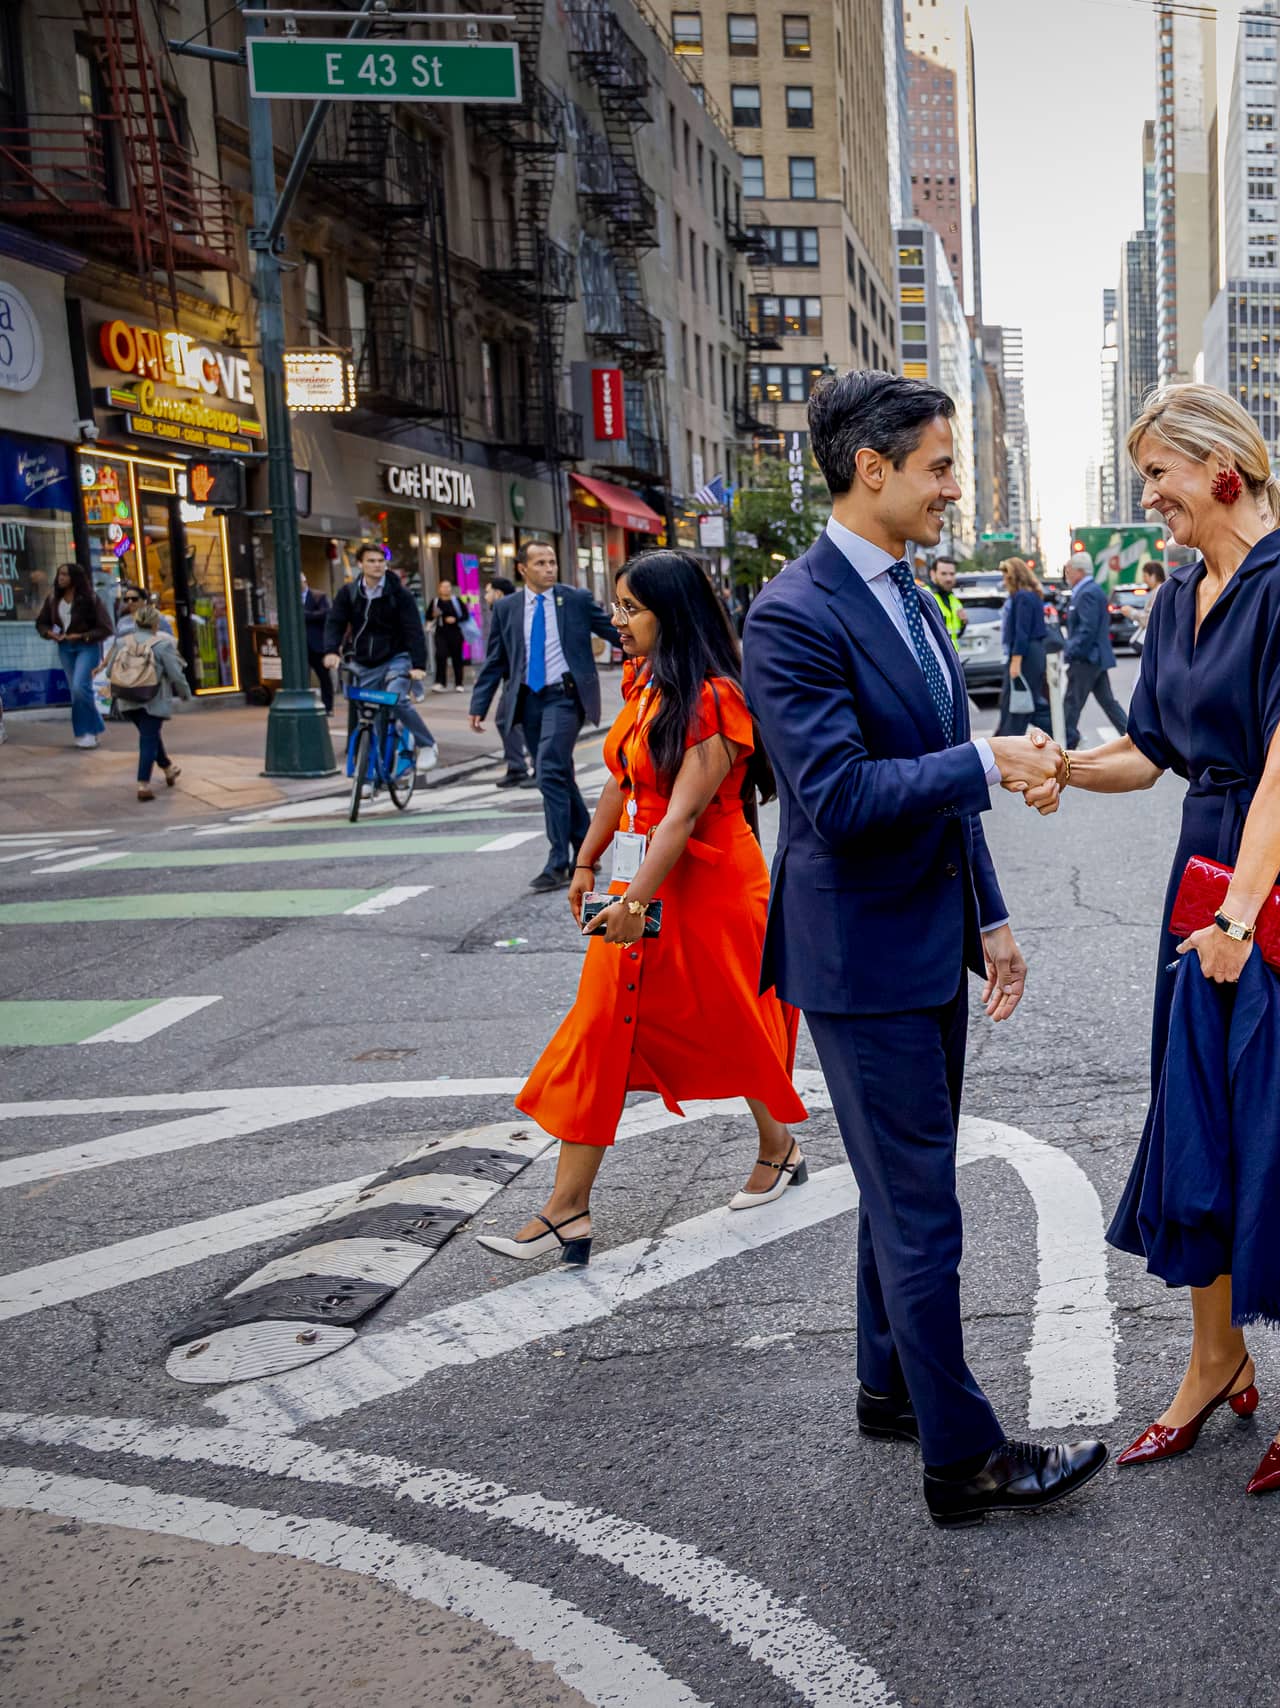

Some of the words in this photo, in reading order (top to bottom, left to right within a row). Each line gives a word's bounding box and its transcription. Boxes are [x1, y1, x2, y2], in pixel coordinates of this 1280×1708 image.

[325, 53, 345, 86] E
[357, 54, 397, 87] 43
[411, 55, 444, 88] St
[138, 379, 239, 434] Convenience
[388, 465, 422, 498] CAFÉ
[420, 463, 476, 509] HESTIA
